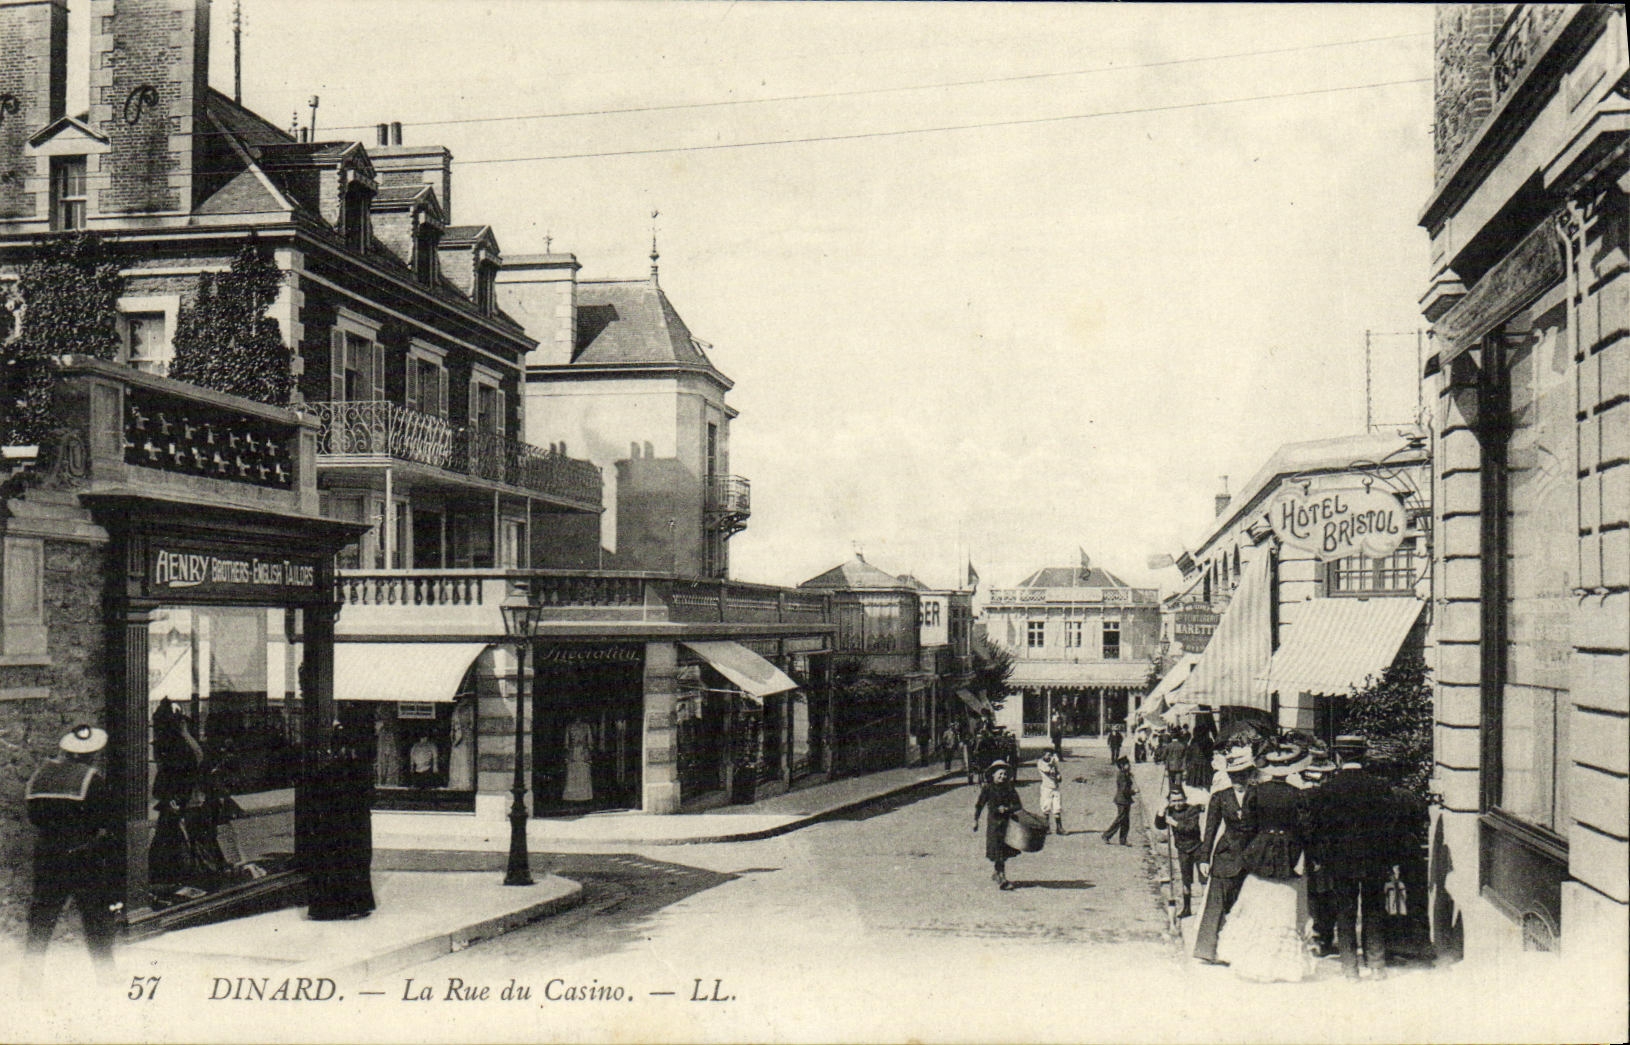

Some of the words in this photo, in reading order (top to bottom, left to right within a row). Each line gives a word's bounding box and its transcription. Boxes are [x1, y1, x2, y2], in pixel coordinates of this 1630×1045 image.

[1323, 510, 1399, 552] BRISTOL
[155, 550, 210, 588] HENRY
[283, 560, 314, 586] TAILORS
